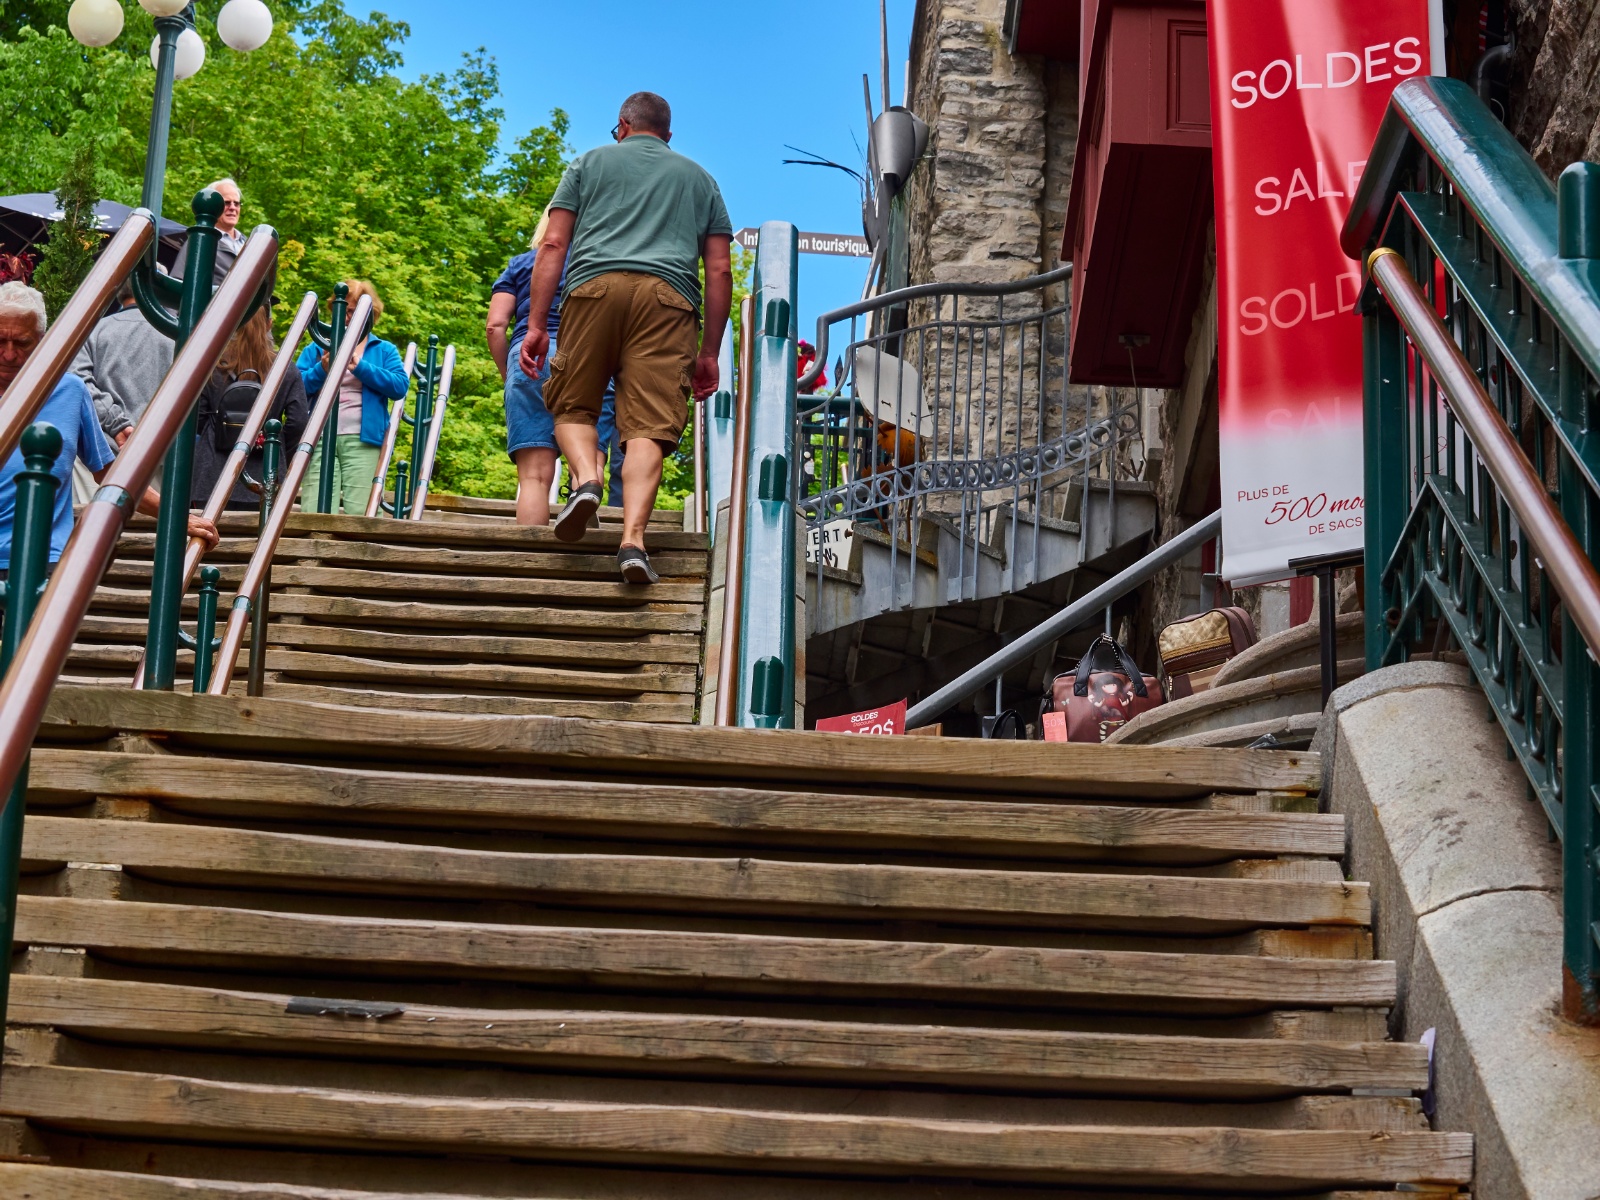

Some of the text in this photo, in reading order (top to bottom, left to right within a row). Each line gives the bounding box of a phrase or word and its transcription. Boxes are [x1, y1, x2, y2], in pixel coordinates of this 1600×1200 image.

[1231, 37, 1422, 109] SOLDES
[1254, 160, 1367, 216] SALE
[1239, 272, 1362, 336] SOLD
[1264, 397, 1343, 440] SAL
[1237, 485, 1290, 502] PLUS DE
[1264, 493, 1328, 525] 500
[1309, 517, 1363, 535] DE SACS
[850, 711, 879, 723] SOLDES
[1044, 717, 1065, 729] 50%
